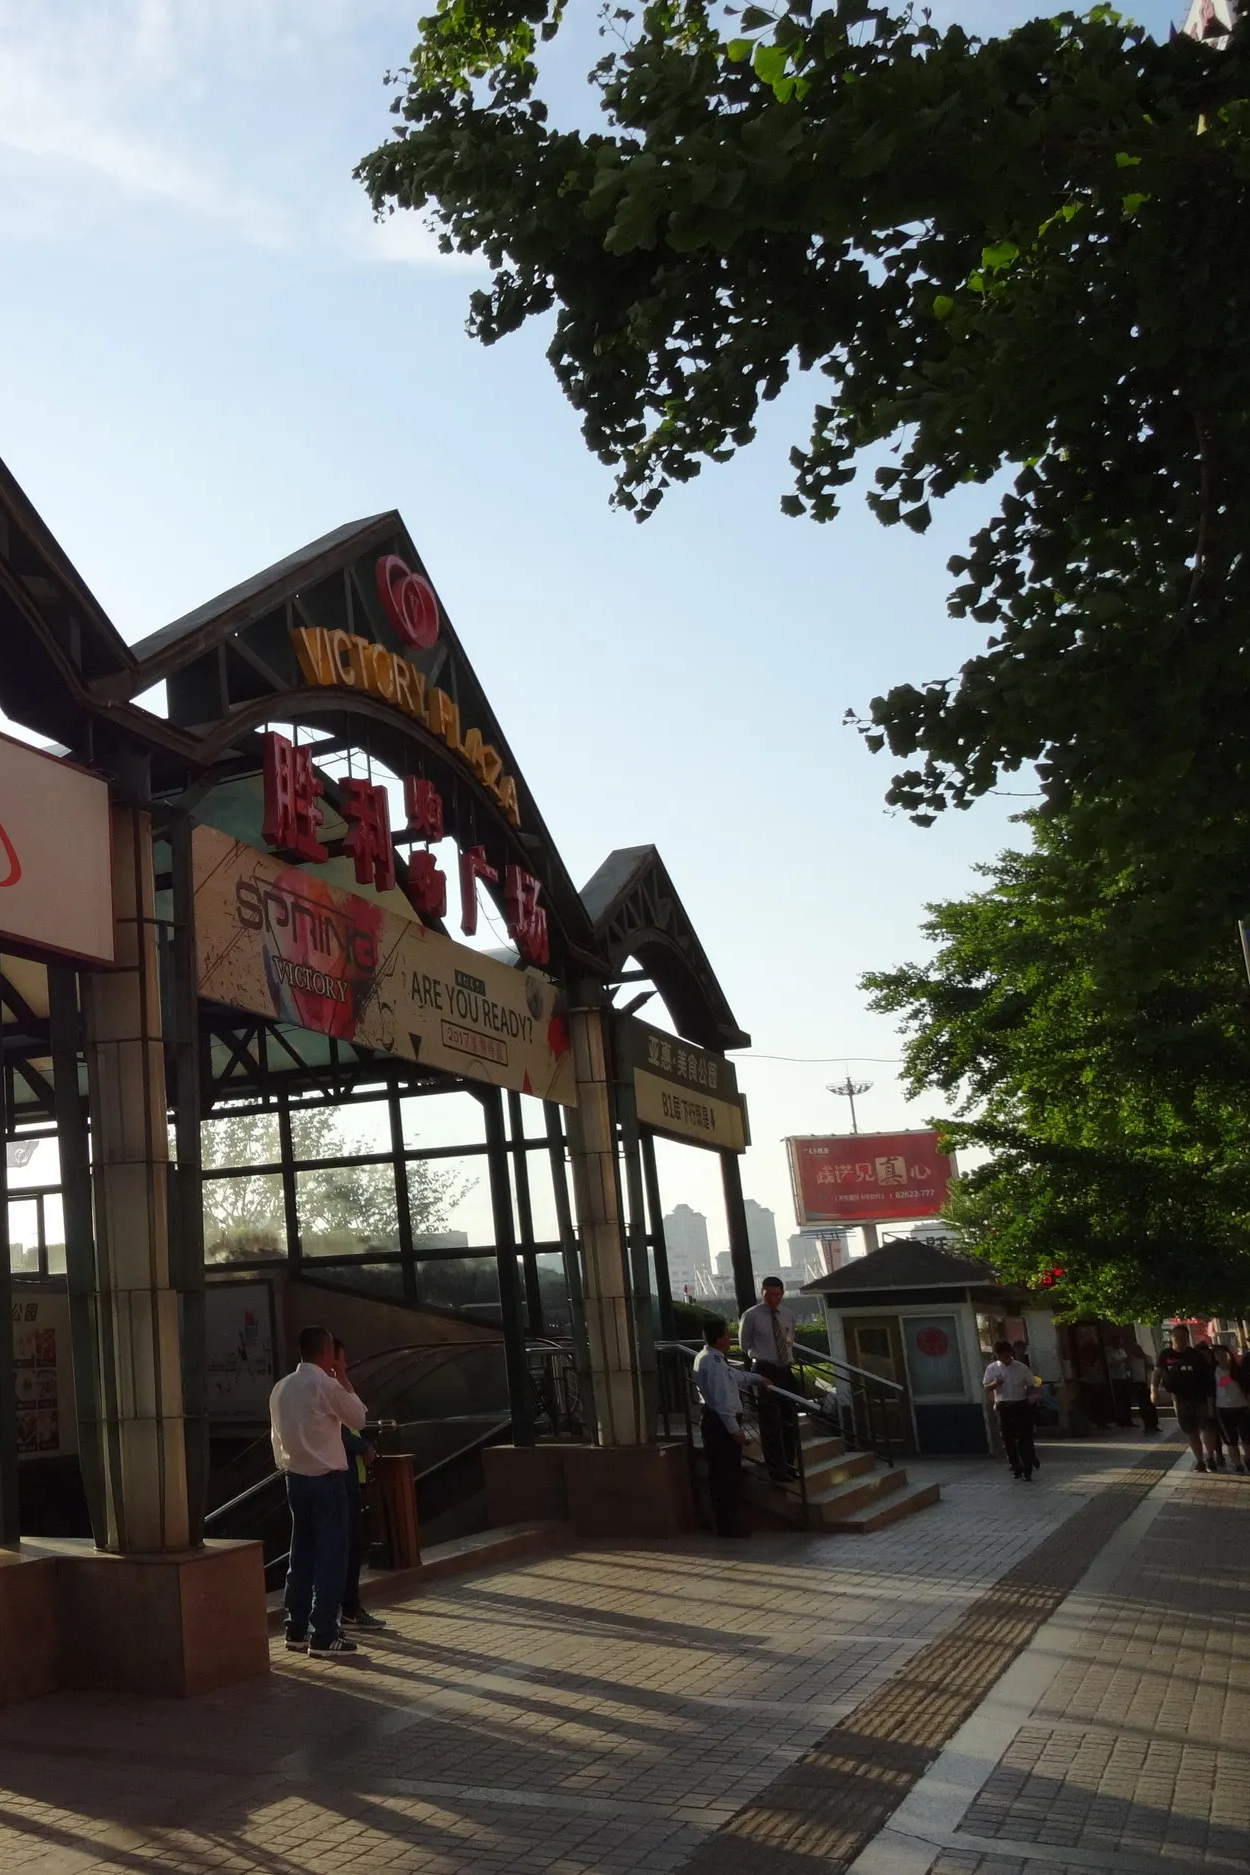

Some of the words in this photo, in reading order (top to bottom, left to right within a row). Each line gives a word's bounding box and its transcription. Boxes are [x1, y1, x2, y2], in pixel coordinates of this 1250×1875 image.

[291, 626, 429, 718] VICTORY
[429, 687, 522, 827] PLAZA
[235, 879, 375, 971] SPRING
[274, 955, 348, 1003] VICTORY
[411, 970, 443, 1011] ARE
[445, 984, 479, 1024] YOU
[482, 999, 534, 1044] READY?
